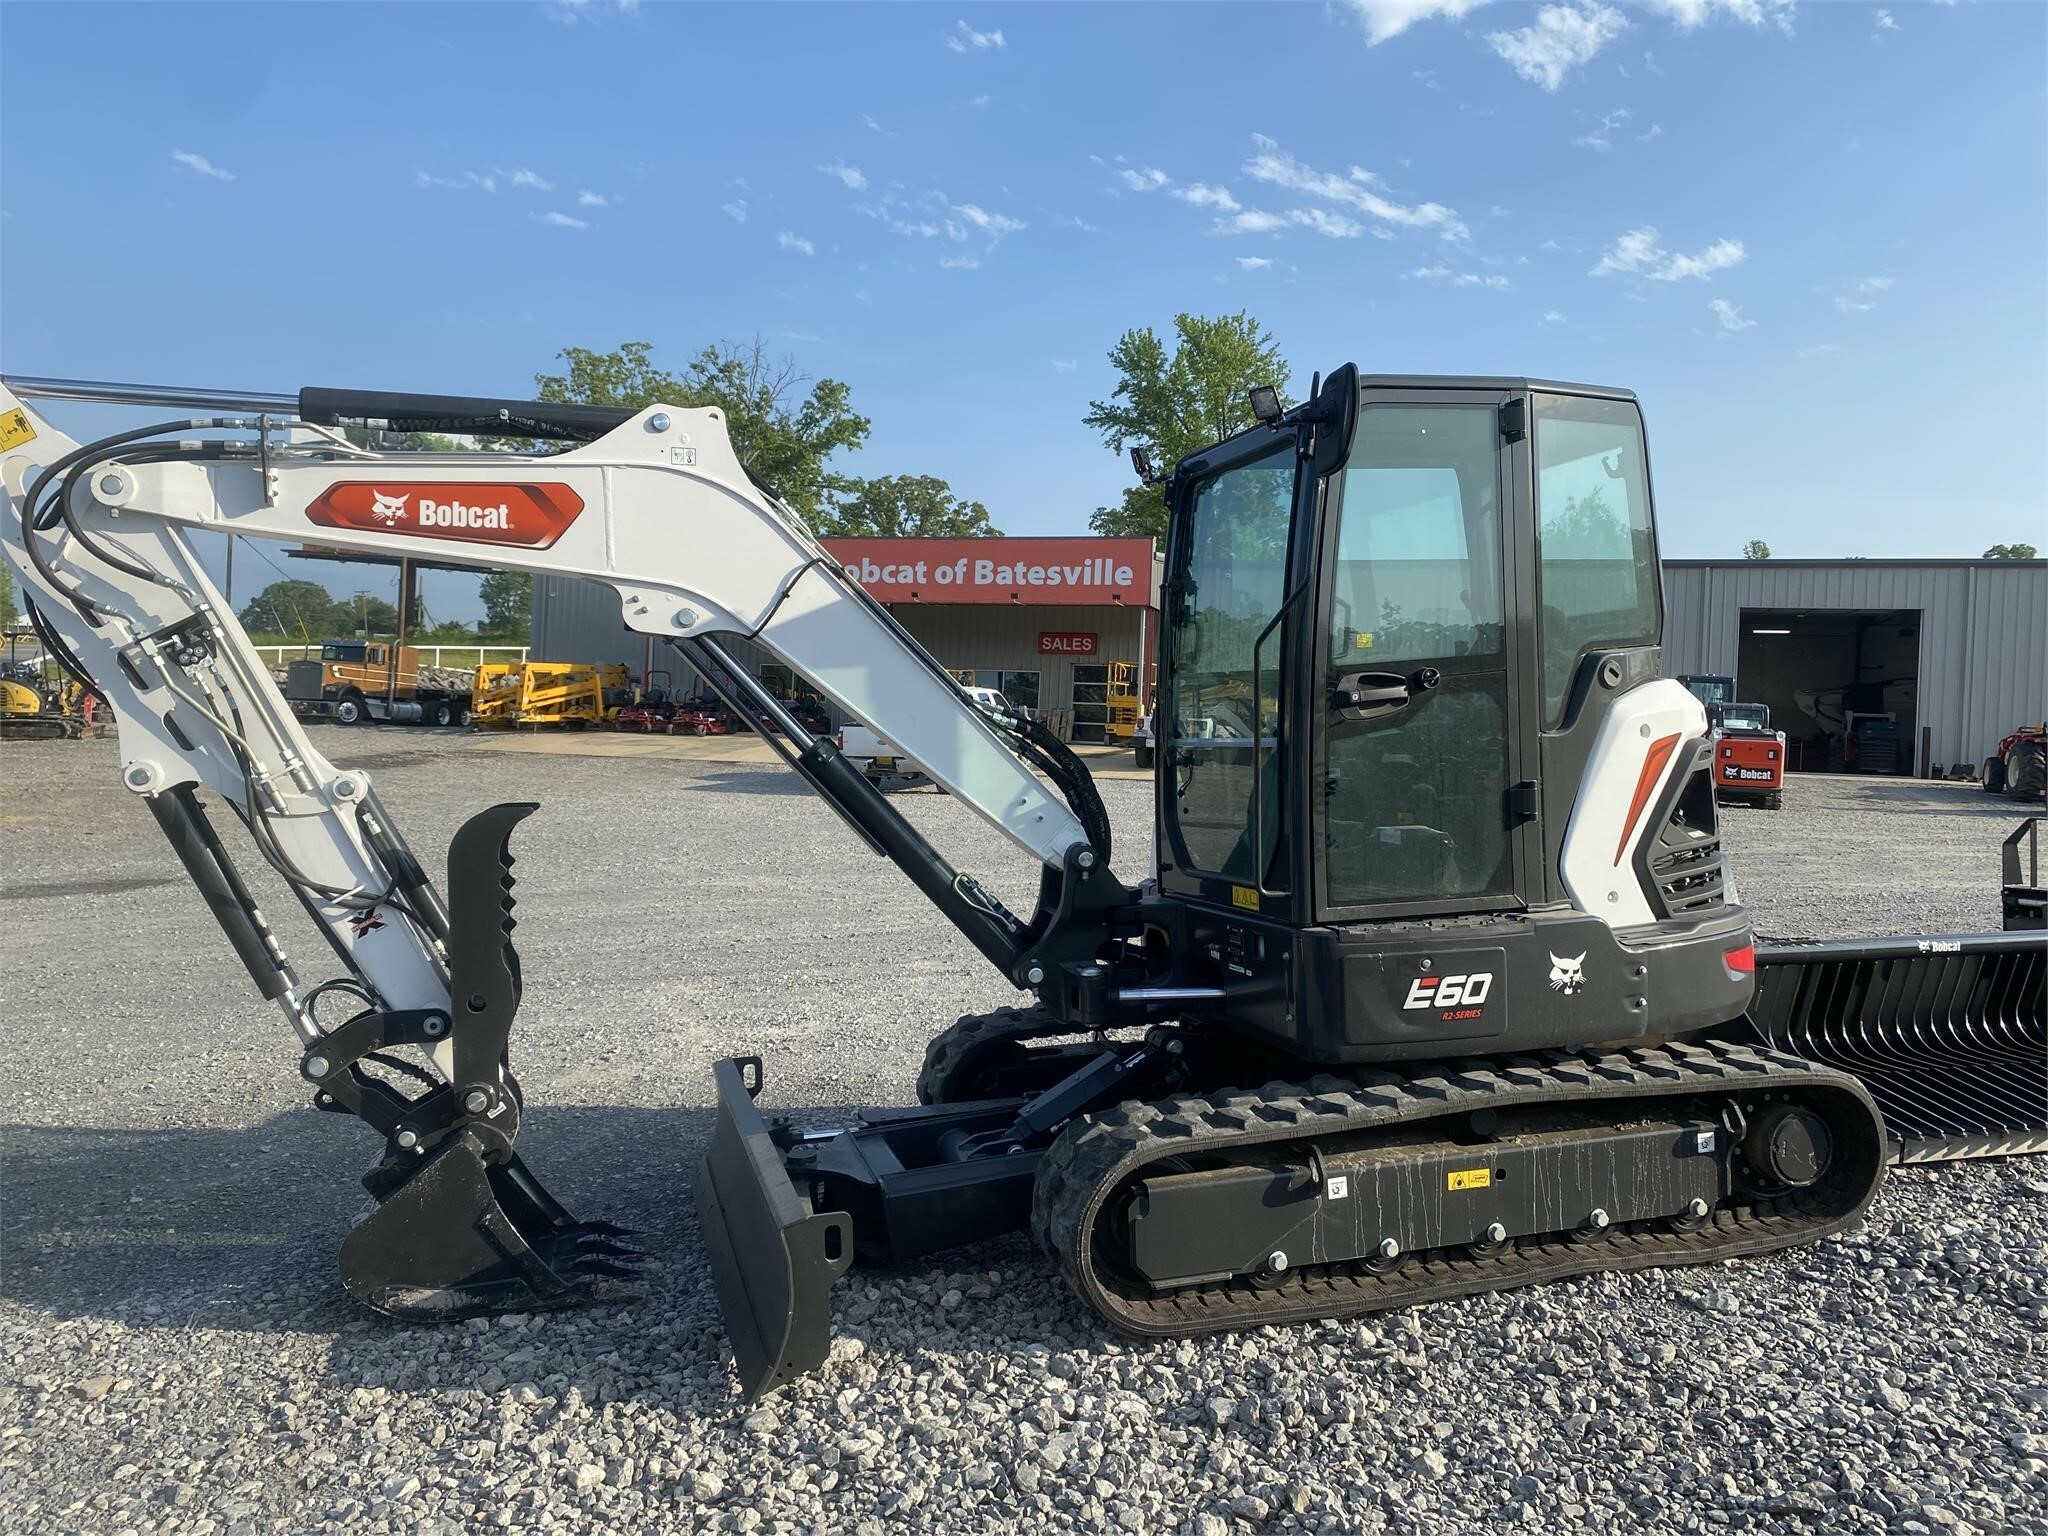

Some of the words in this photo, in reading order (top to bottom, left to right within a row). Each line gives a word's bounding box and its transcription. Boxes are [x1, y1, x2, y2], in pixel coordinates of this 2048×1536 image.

[419, 499, 509, 530] Bobcat
[842, 557, 928, 585] obcat
[934, 558, 968, 585] of
[974, 558, 1134, 586] Batesville
[1042, 637, 1092, 651] SALES
[1740, 769, 1772, 780] Bobcat
[1931, 940, 1961, 952] Bobcat
[1402, 972, 1494, 1010] E60
[1441, 1008, 1482, 1020] R2-SERIES
